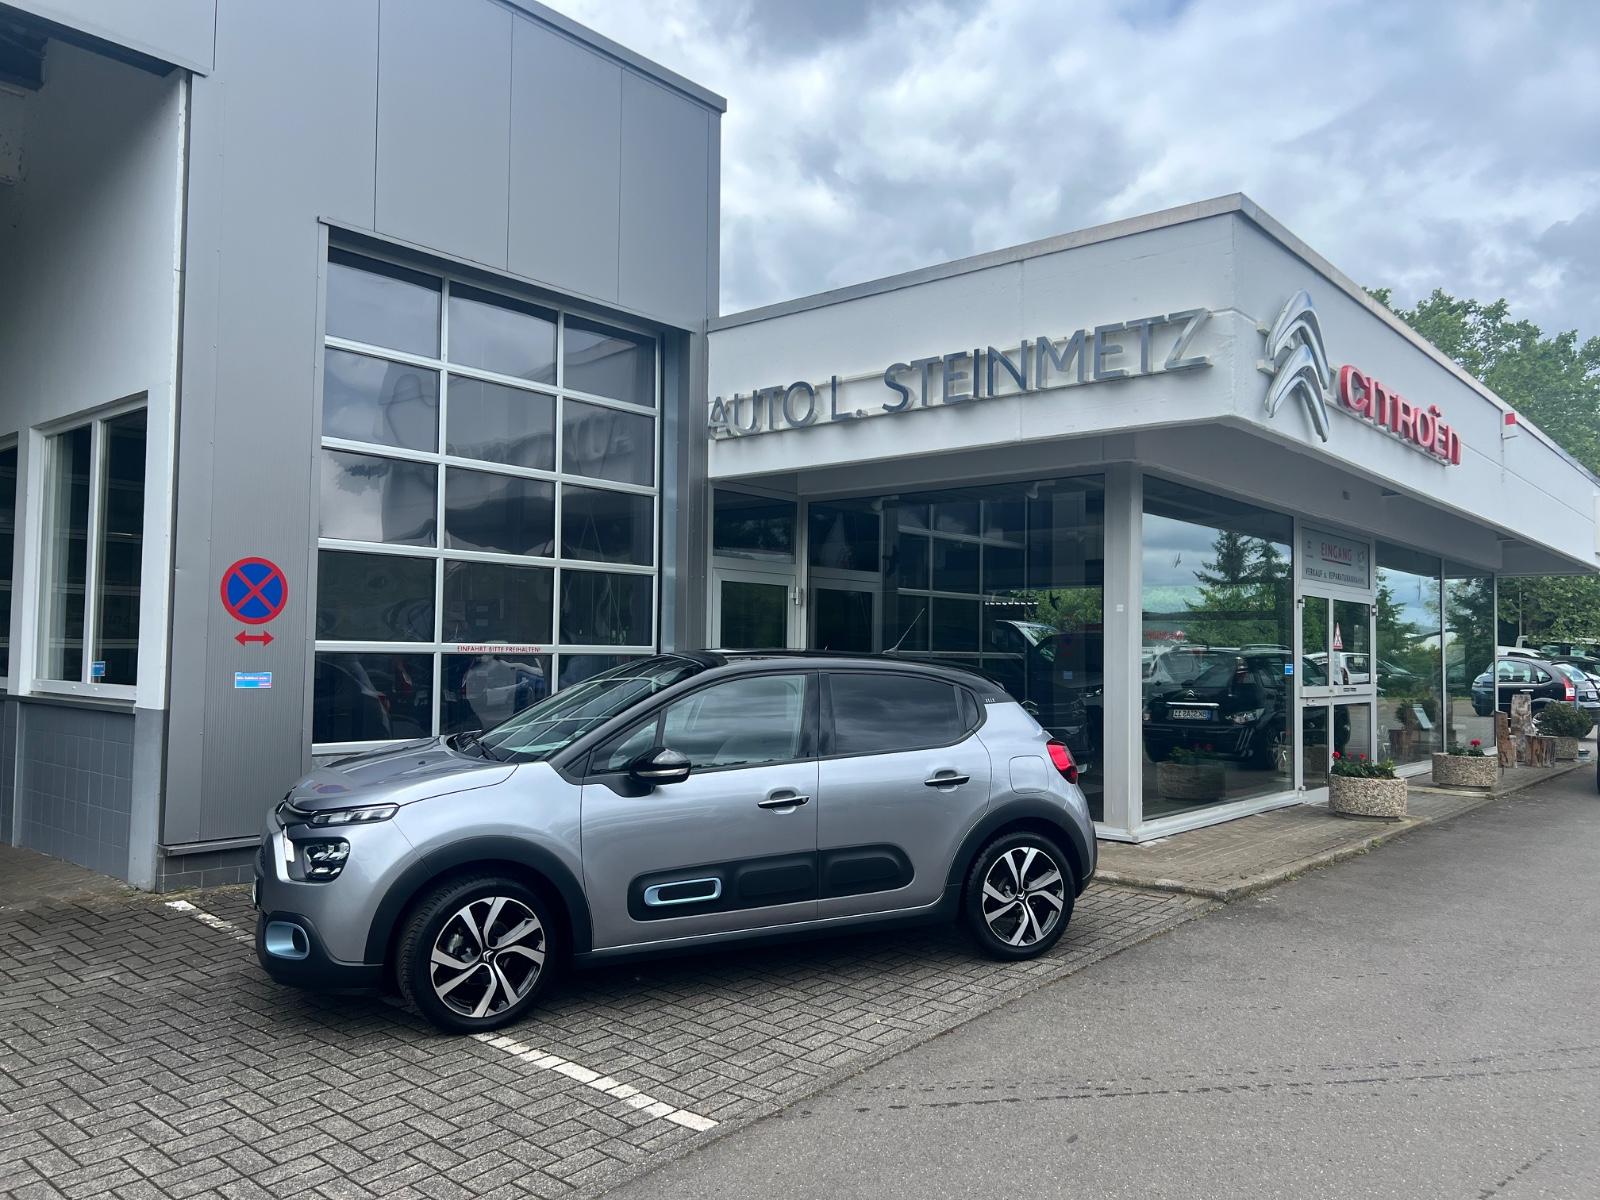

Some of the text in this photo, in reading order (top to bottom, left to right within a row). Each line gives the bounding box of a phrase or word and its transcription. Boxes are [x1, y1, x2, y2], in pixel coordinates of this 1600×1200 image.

[708, 308, 1213, 438] AUTO L. STEINMETZ
[1321, 542, 1352, 561] EINGANG
[457, 645, 486, 653] EINFAHRT
